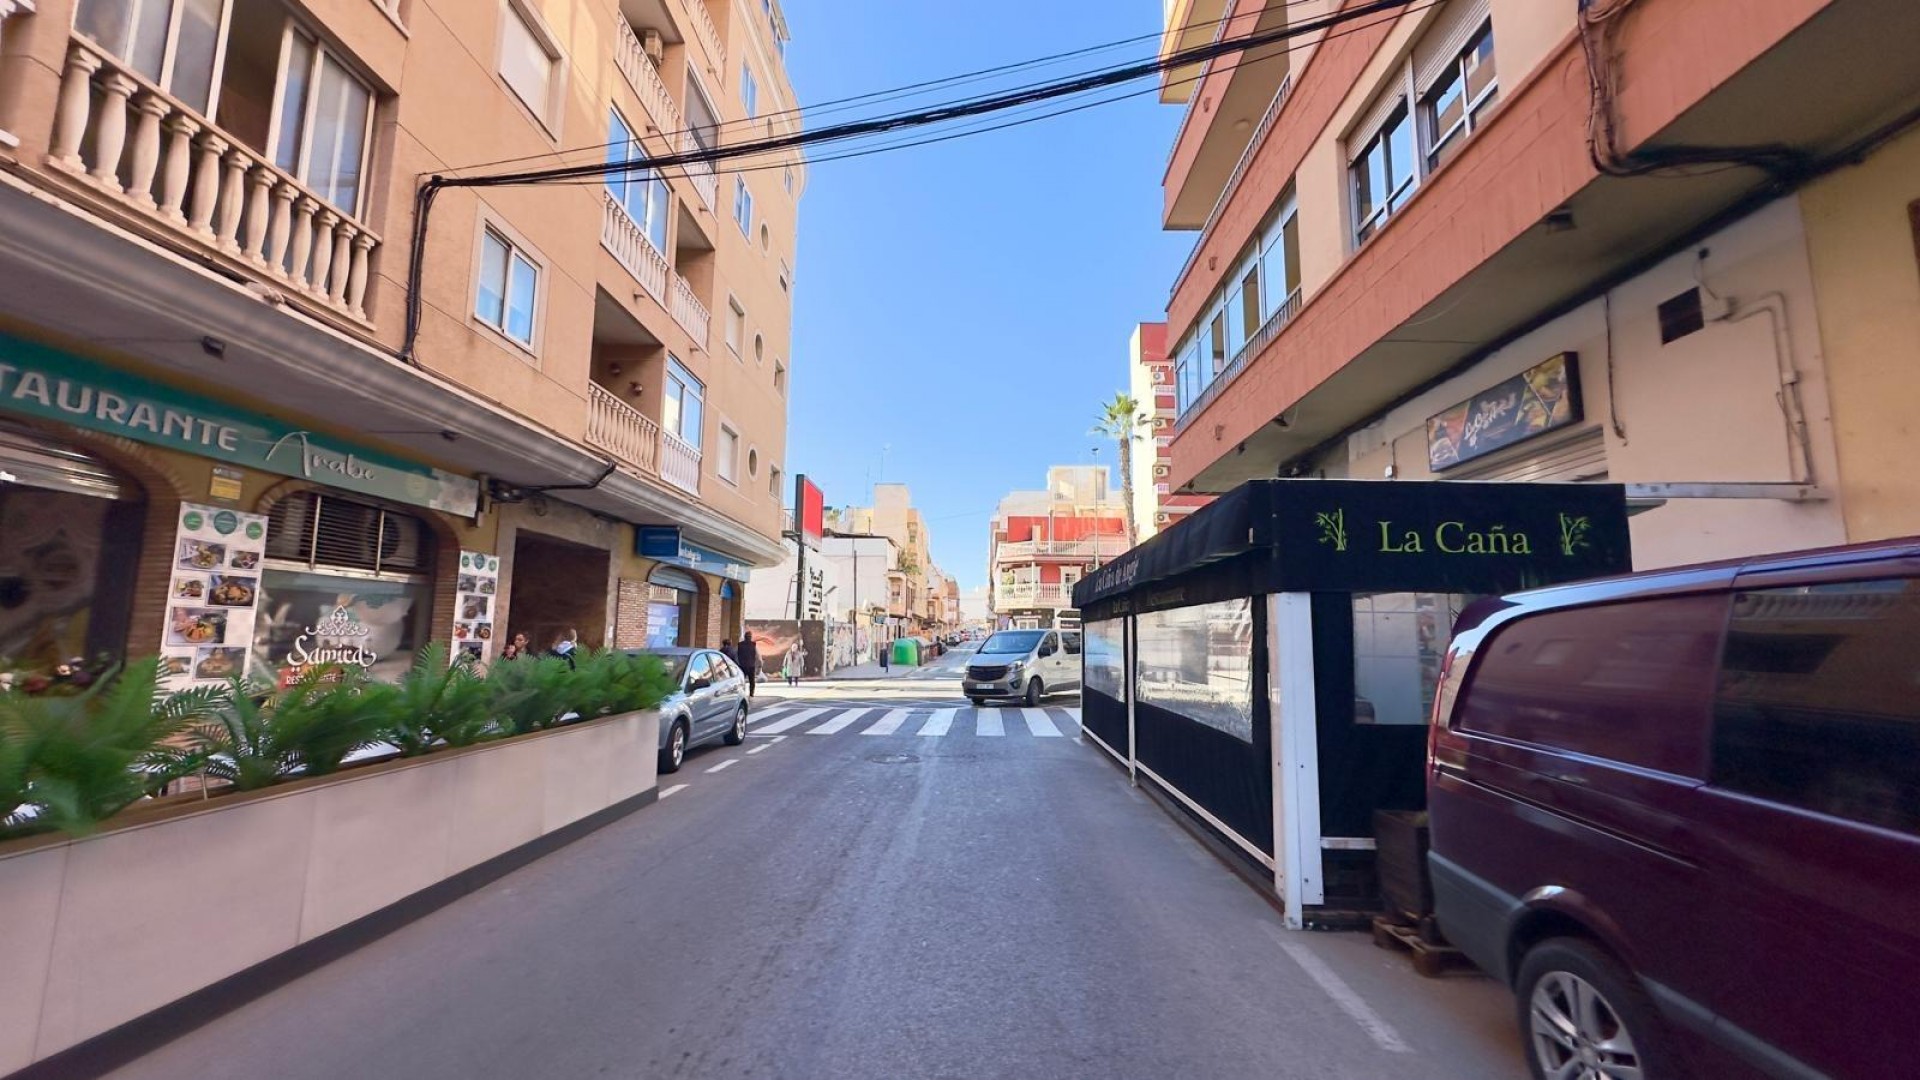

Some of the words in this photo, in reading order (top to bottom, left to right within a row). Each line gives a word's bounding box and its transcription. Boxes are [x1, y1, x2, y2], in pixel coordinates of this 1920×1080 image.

[1377, 520, 1424, 553] La
[1435, 520, 1532, 554] Caña
[287, 635, 377, 668] Samira
